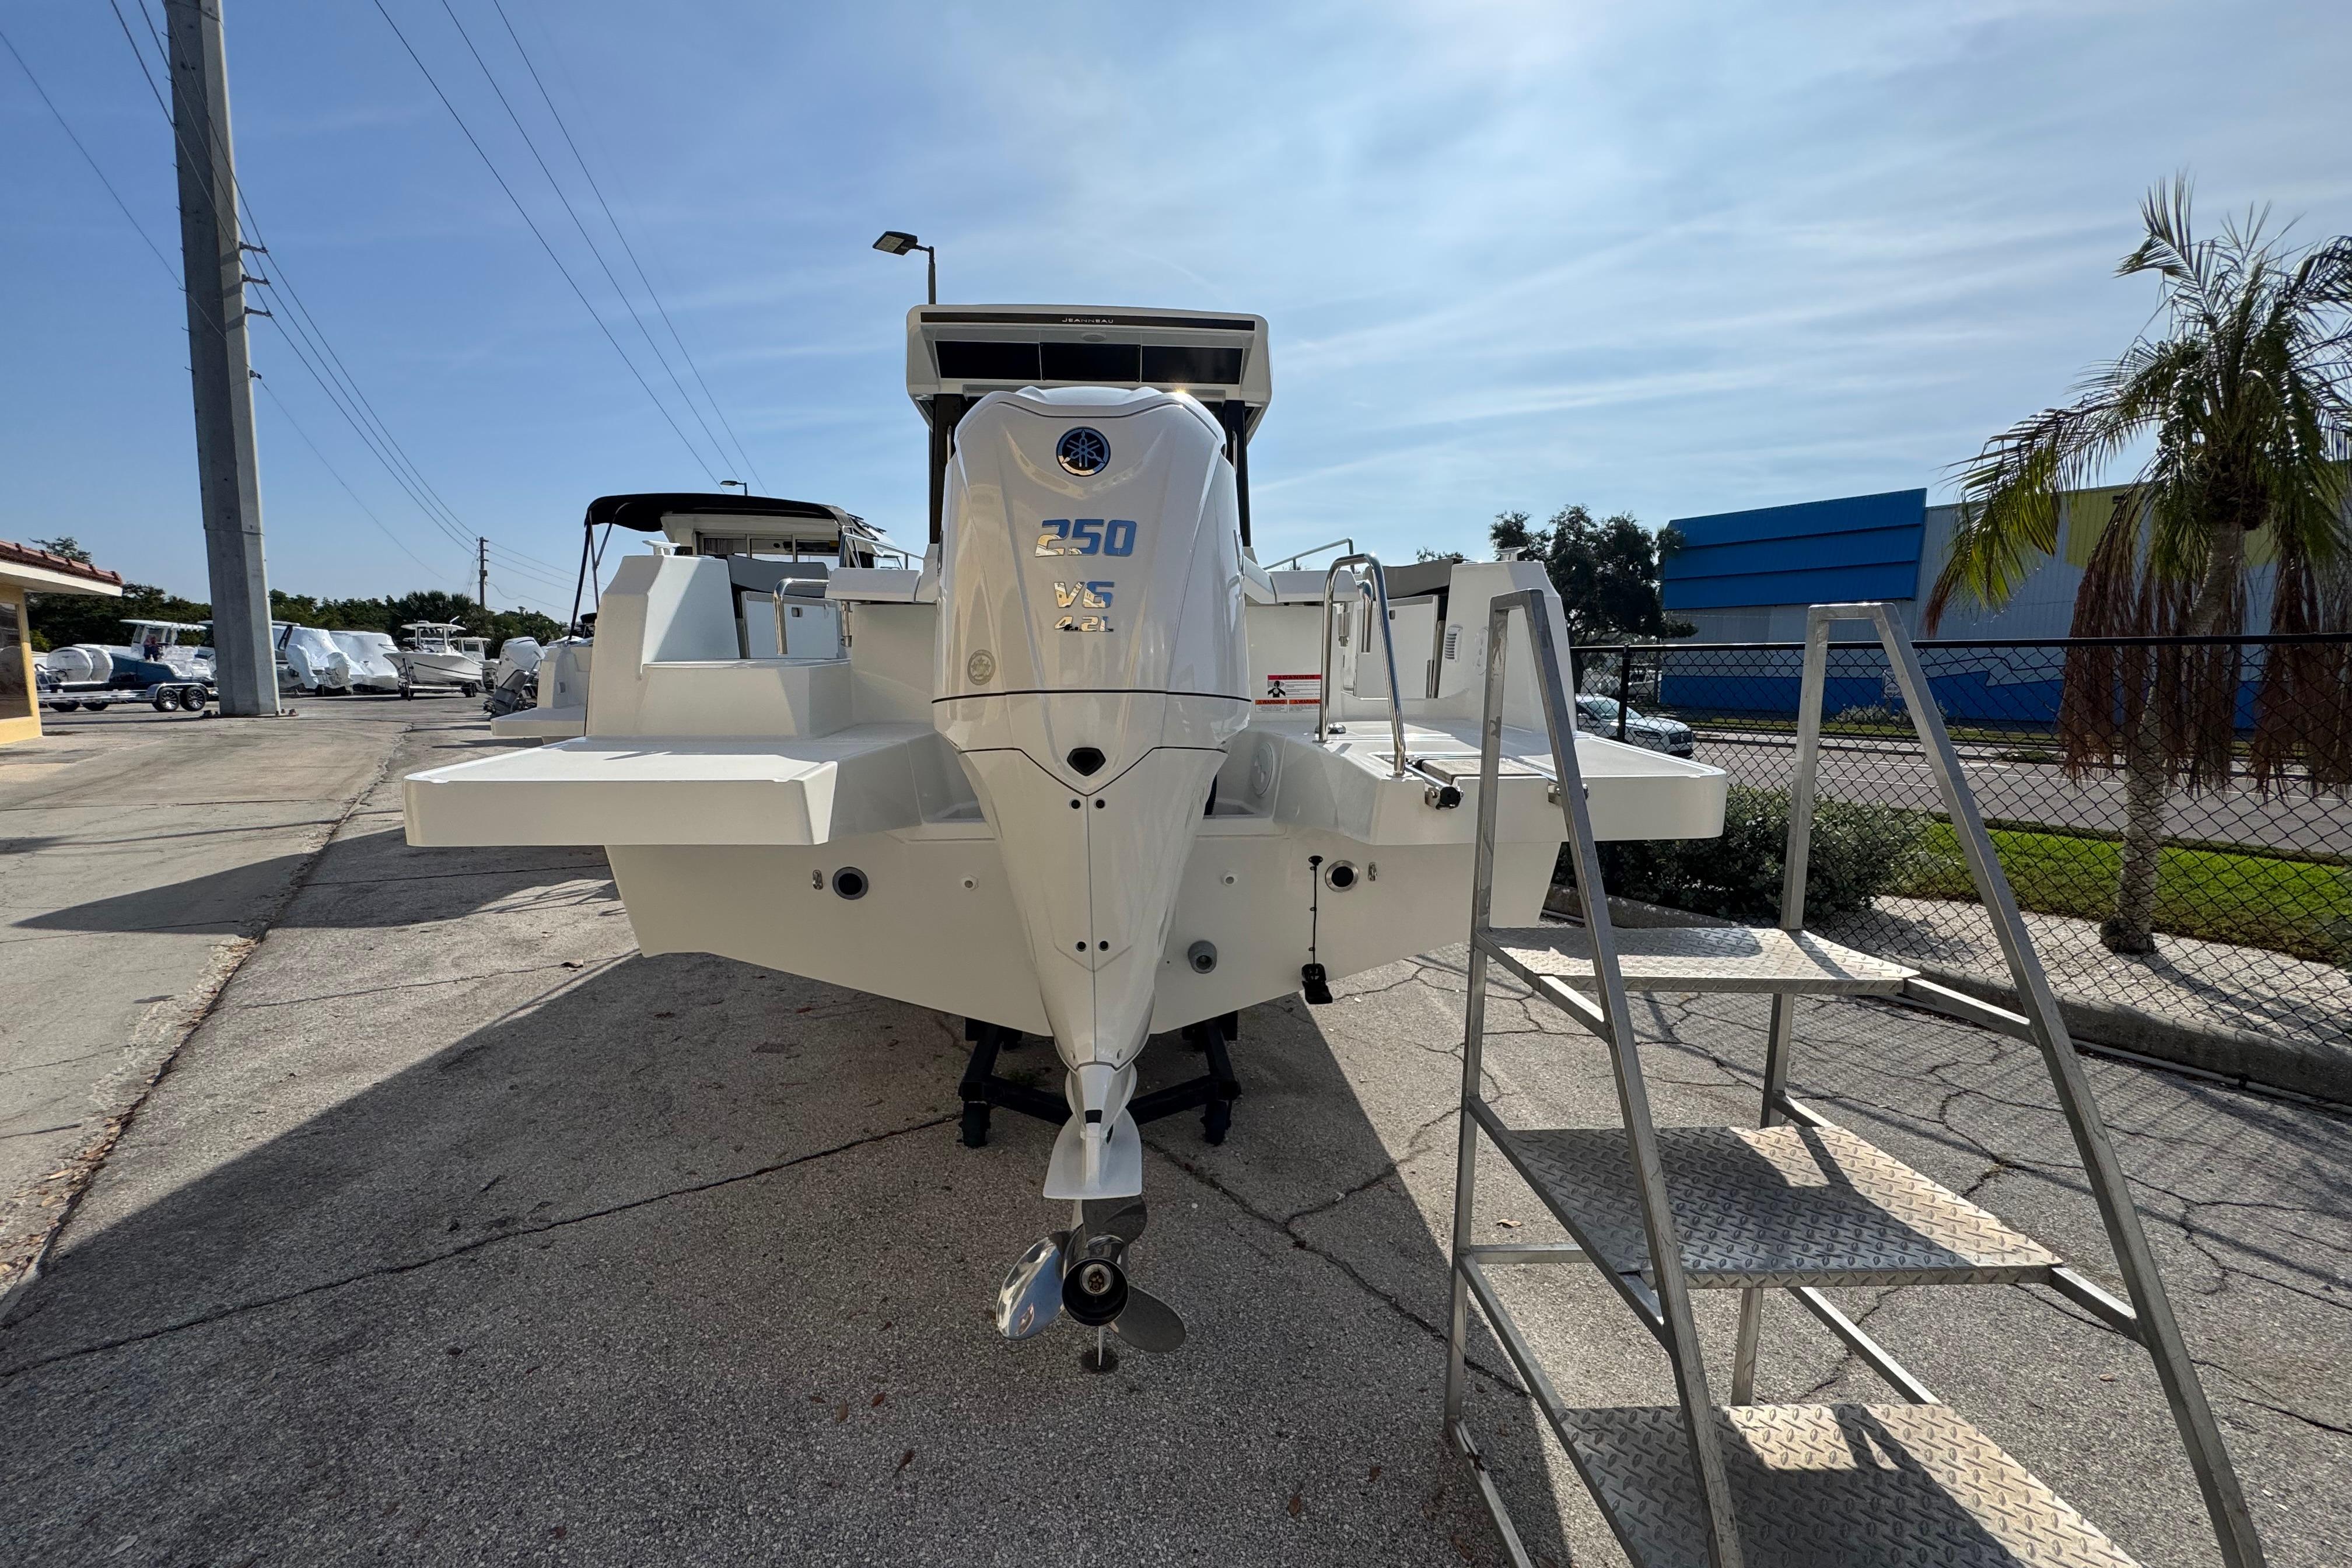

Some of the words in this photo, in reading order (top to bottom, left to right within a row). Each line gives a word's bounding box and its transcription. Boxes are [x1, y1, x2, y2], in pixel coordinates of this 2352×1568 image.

[1035, 519, 1137, 557] 250
[1054, 582, 1115, 608] V6
[1055, 616, 1114, 632] 4.2L
